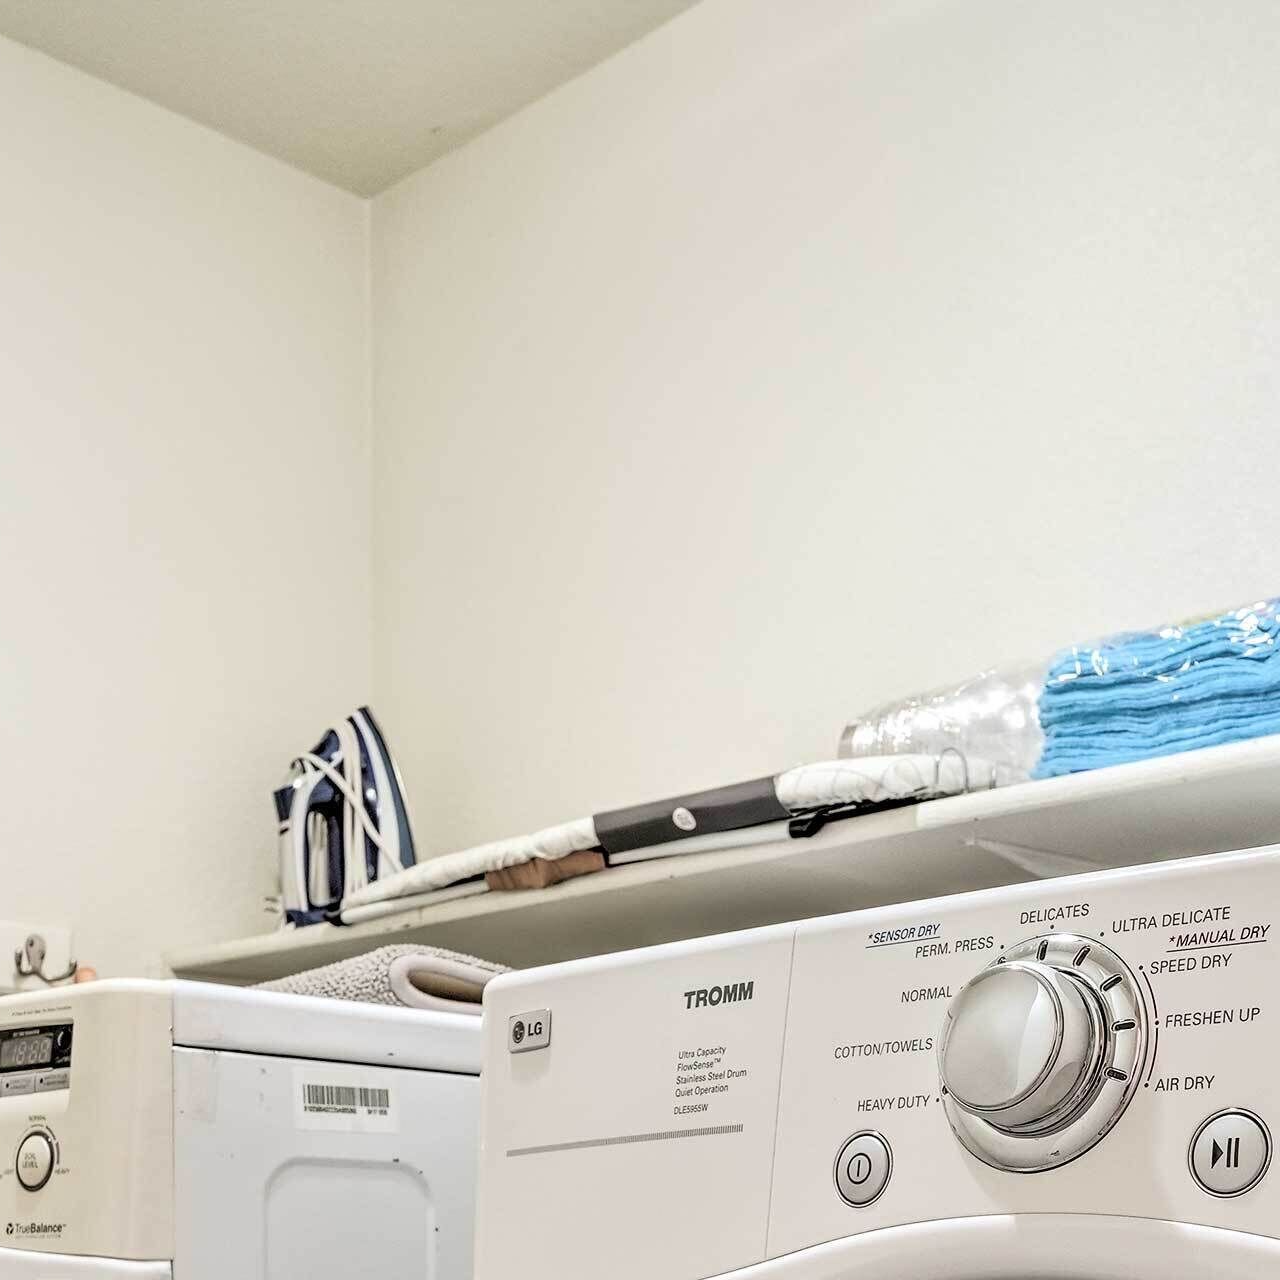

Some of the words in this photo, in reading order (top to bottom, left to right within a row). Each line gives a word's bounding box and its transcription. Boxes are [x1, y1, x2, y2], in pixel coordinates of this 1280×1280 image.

[1020, 903, 1090, 925] DELICATES
[1112, 916, 1157, 933] ULTRA
[1162, 906, 1231, 927] DELICATE
[918, 923, 941, 937] DRY
[1240, 924, 1271, 940] DRY
[915, 942, 951, 958] PERM.
[955, 936, 994, 952] PRESS
[1150, 958, 1197, 975] SPEED
[1202, 953, 1232, 970] DRY
[684, 981, 754, 1010] TROMM
[901, 985, 952, 1003] NORMAL
[1166, 1010, 1234, 1028] FRESHEN
[1239, 1007, 1261, 1023] UP
[678, 1050, 695, 1060] Ultra
[696, 1046, 727, 1058] Capacity
[834, 1037, 933, 1059] COTTON/TOWELS
[676, 1075, 707, 1086] Stainless
[707, 1071, 726, 1081] Steel
[727, 1069, 748, 1079] Drum
[1155, 1078, 1180, 1092] AIR
[1184, 1075, 1215, 1091] DRY
[675, 1088, 694, 1098] Quiet
[694, 1084, 729, 1096] Operation
[858, 1097, 894, 1112] HEAVY
[897, 1095, 930, 1109] DUTY
